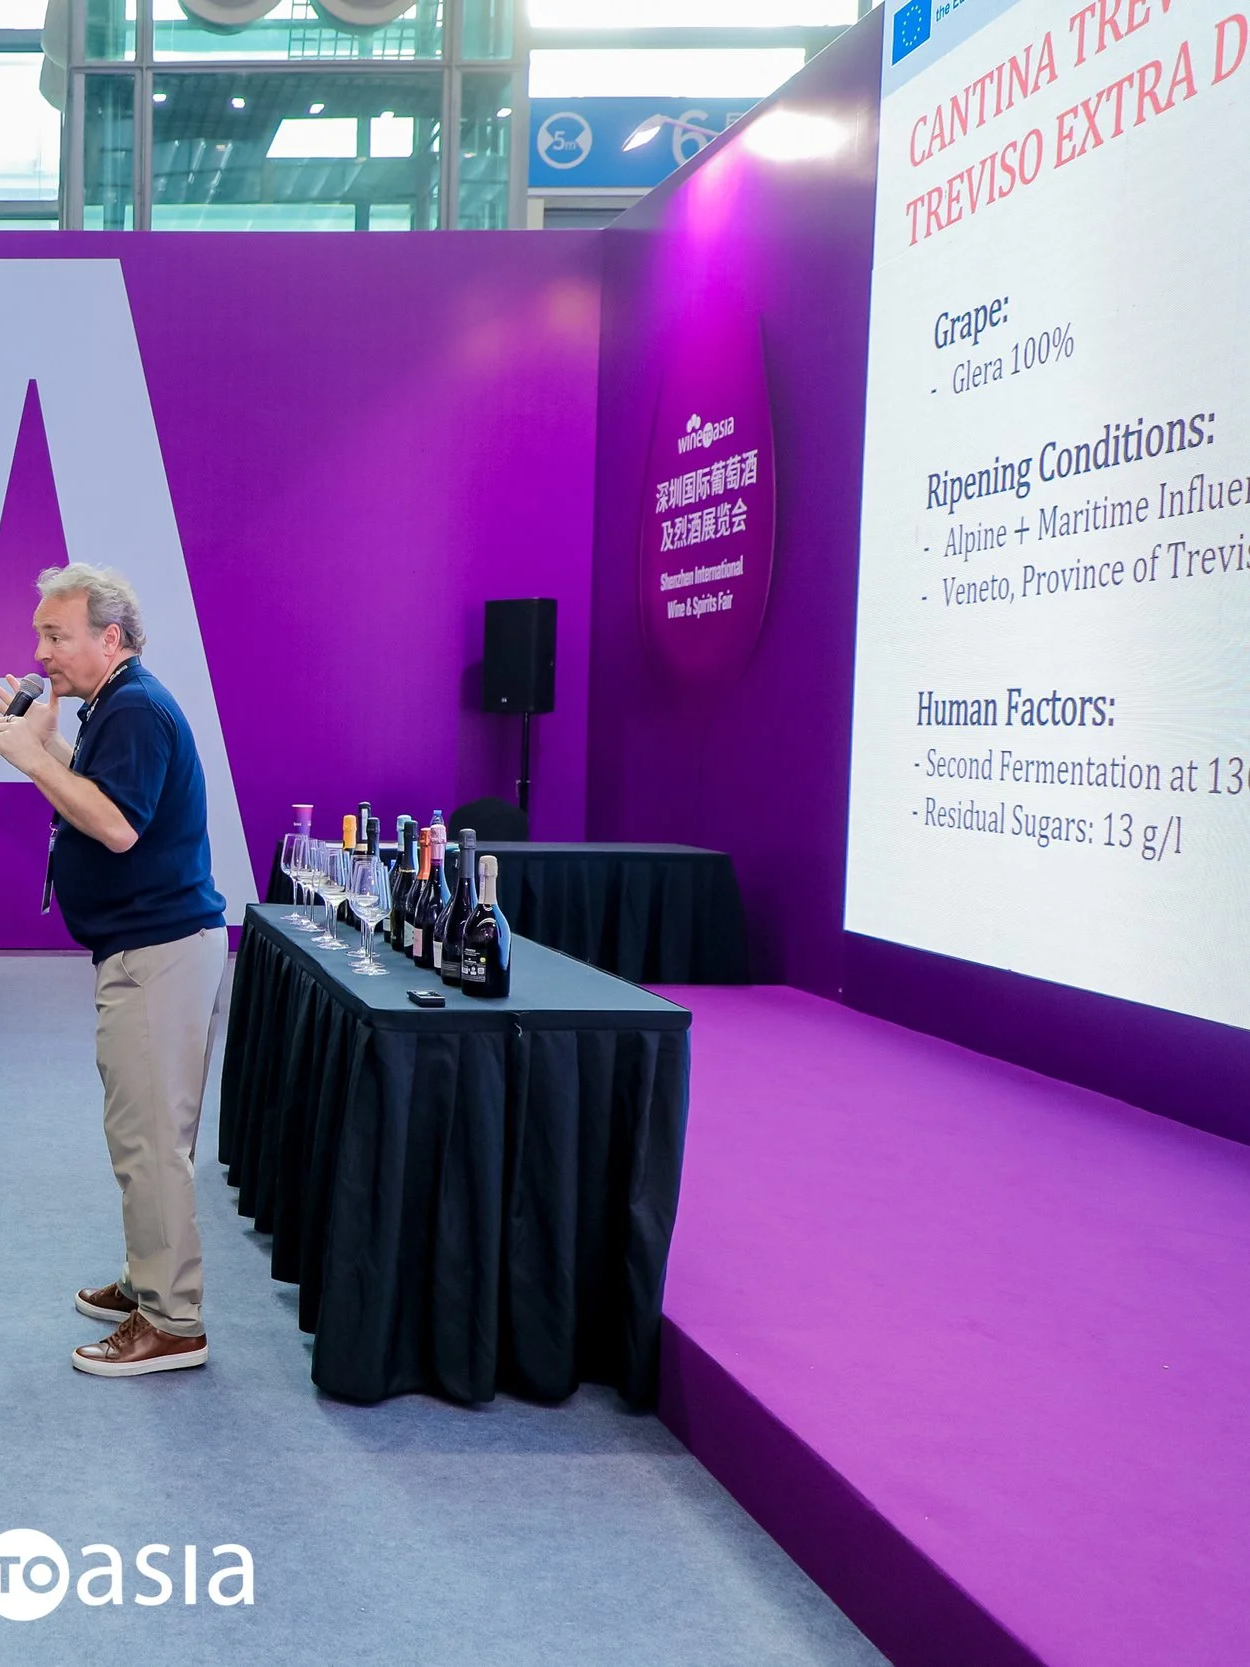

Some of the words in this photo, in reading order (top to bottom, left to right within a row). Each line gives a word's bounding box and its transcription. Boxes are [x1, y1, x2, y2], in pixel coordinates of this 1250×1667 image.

[910, 31, 1058, 167] CANTINA
[1069, 0, 1171, 67] TRE
[553, 131, 576, 150] 5m
[906, 128, 1043, 247] TREVISO
[1054, 40, 1197, 169] EXTRA
[934, 296, 1009, 350] Grape:
[953, 357, 1003, 394] Glera
[1011, 322, 1074, 375] 100%
[655, 449, 758, 513] 深圳国际葡萄酒
[926, 457, 1033, 514] Ripening
[1039, 412, 1216, 483] Conditions:
[659, 497, 748, 552] 及烈酒展览会
[943, 522, 1007, 561] Alpine
[1014, 516, 1030, 545] +
[1037, 495, 1149, 542] Maritime
[660, 568, 694, 591] Shenzhen
[694, 555, 744, 585] International
[667, 597, 686, 619] Wine
[686, 596, 692, 616] &
[692, 592, 718, 619] Spirits
[718, 589, 734, 612] Fair
[942, 574, 1015, 606] Veneto,
[1021, 558, 1125, 597] Province
[1133, 543, 1161, 583] of
[917, 691, 997, 726] Human
[1005, 688, 1116, 726] Factors:
[926, 748, 993, 781] Second
[999, 750, 1161, 791] Fermentation
[1170, 760, 1198, 792] at
[1208, 757, 1250, 795] 13
[924, 797, 1005, 834] Residual
[1011, 804, 1094, 848] Sugars:
[1104, 812, 1133, 848] 13
[1141, 815, 1182, 862] g/l
